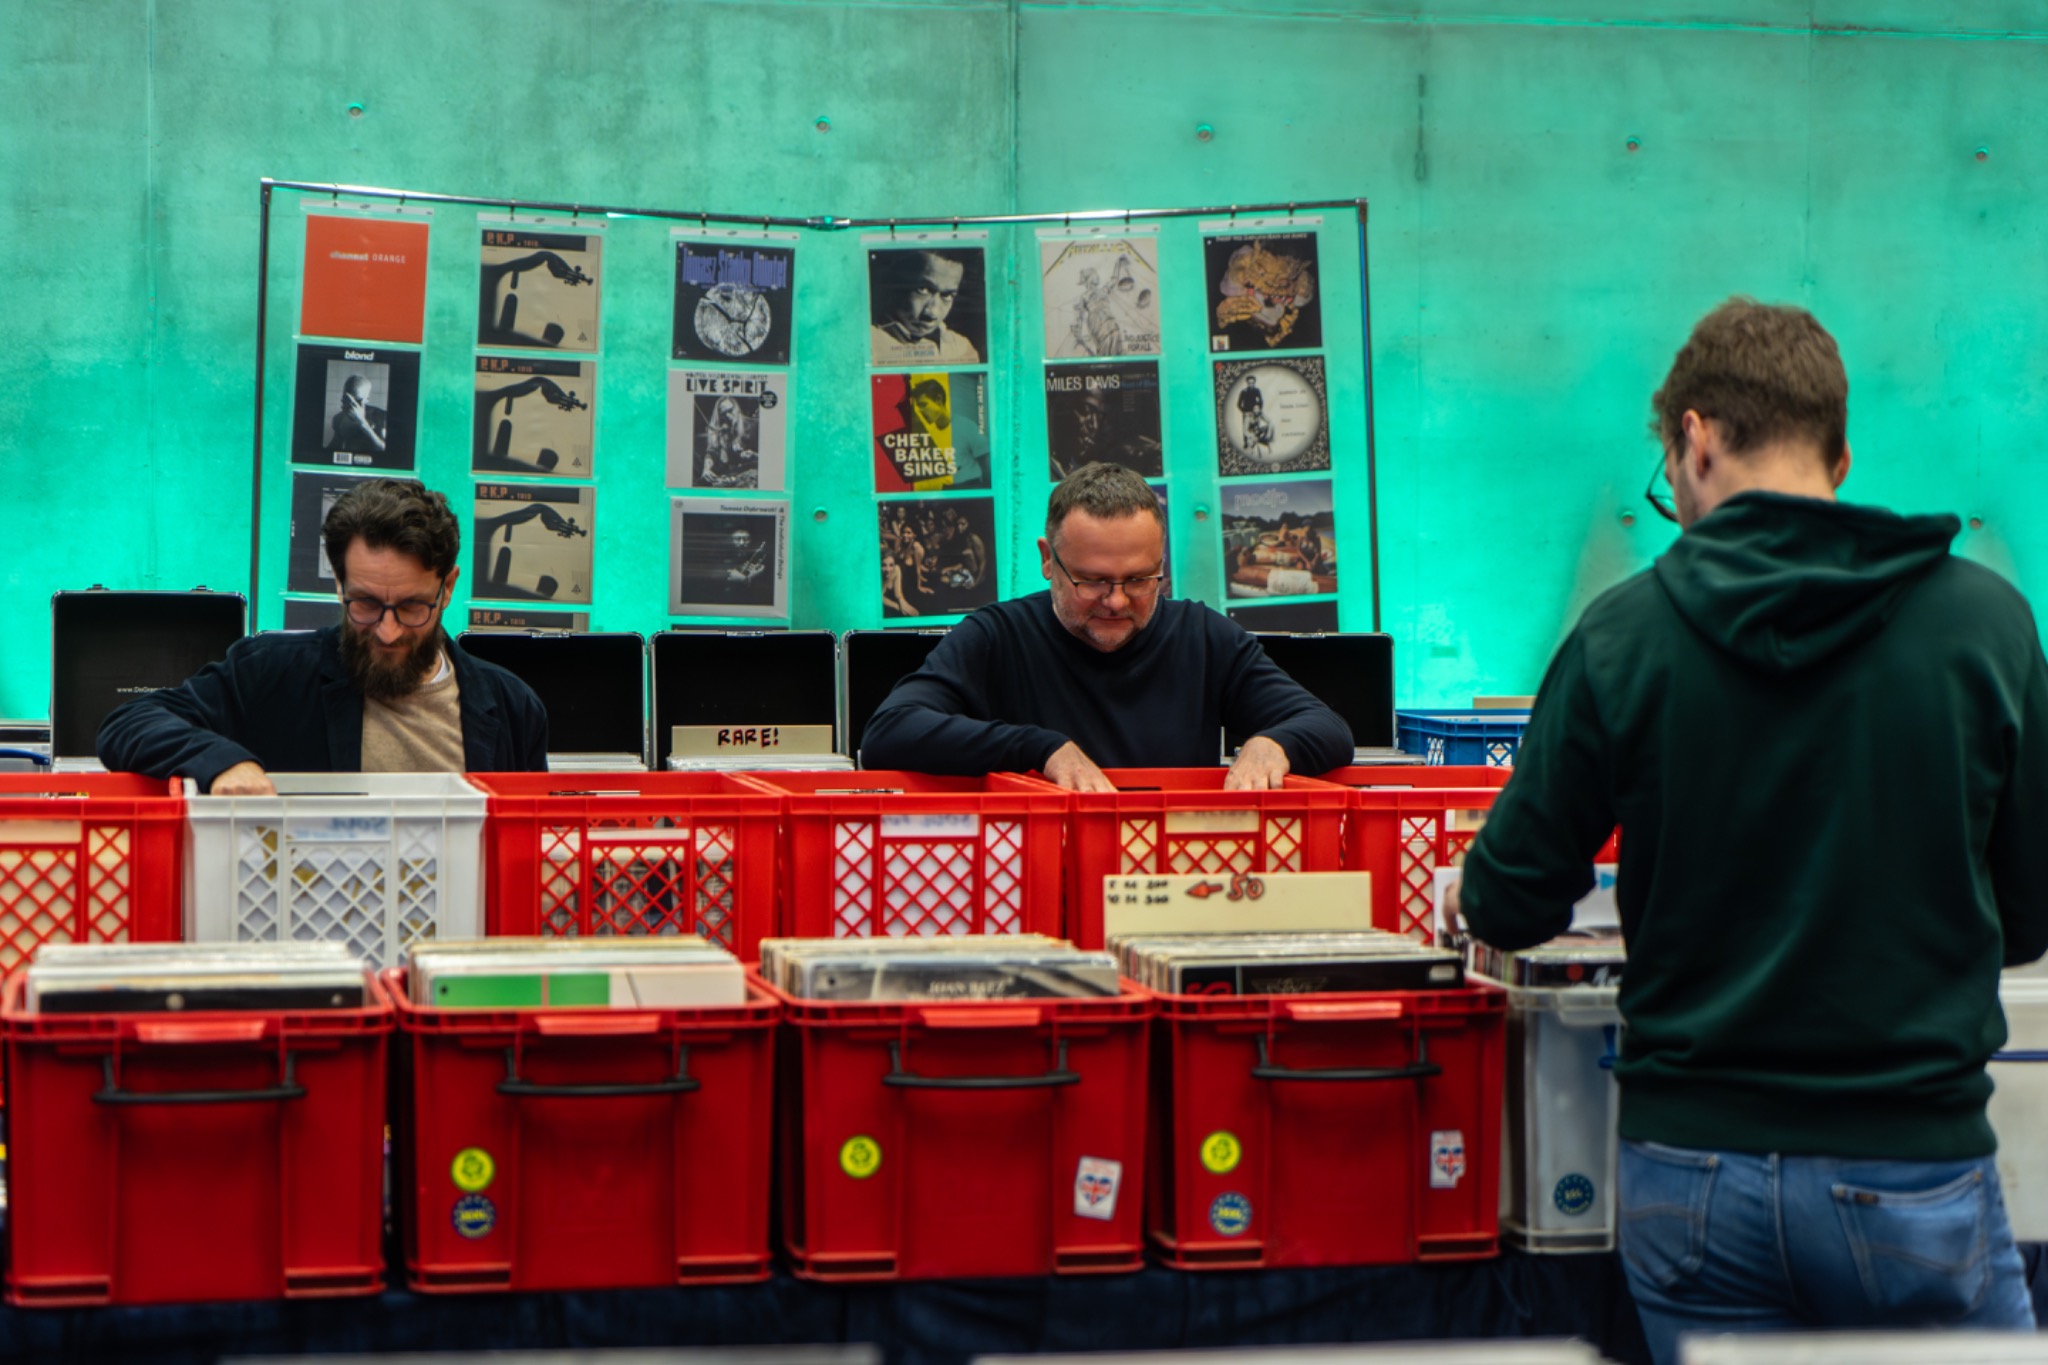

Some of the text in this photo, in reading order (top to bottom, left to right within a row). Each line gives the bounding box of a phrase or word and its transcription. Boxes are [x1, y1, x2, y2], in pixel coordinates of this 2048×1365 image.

[372, 253, 407, 264] ORANGE
[344, 350, 375, 361] blond
[686, 378, 768, 394] LIVE SPIRIT
[1046, 376, 1082, 392] MILES
[1085, 374, 1120, 390] DAVIS
[884, 433, 931, 448] CHET
[895, 447, 956, 463] BAKER
[903, 461, 958, 477] SINGS
[717, 727, 779, 749] RARE!
[1226, 873, 1265, 902] 50
